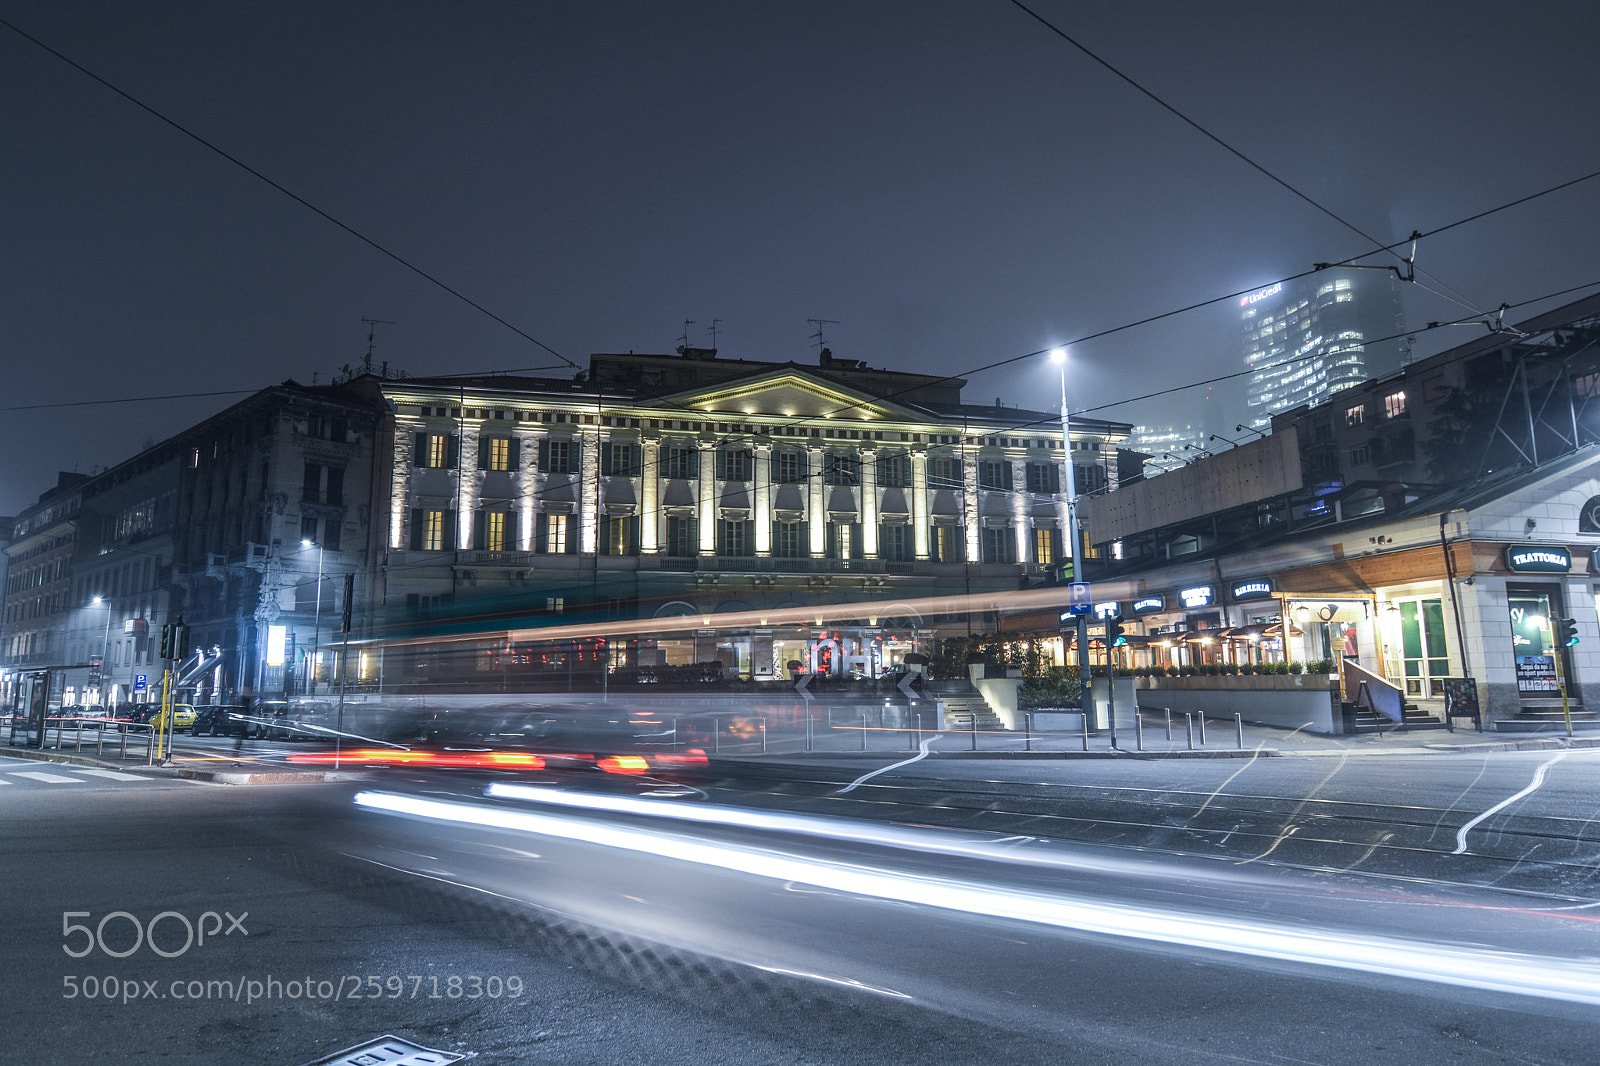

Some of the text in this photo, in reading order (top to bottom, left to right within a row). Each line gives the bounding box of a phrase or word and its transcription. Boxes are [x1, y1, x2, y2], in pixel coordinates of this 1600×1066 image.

[1249, 282, 1282, 304] UniCredit
[1513, 552, 1567, 567] TRATTORIA
[1073, 584, 1085, 600] P
[1234, 583, 1270, 597] BIRRERIA
[137, 675, 145, 683] P
